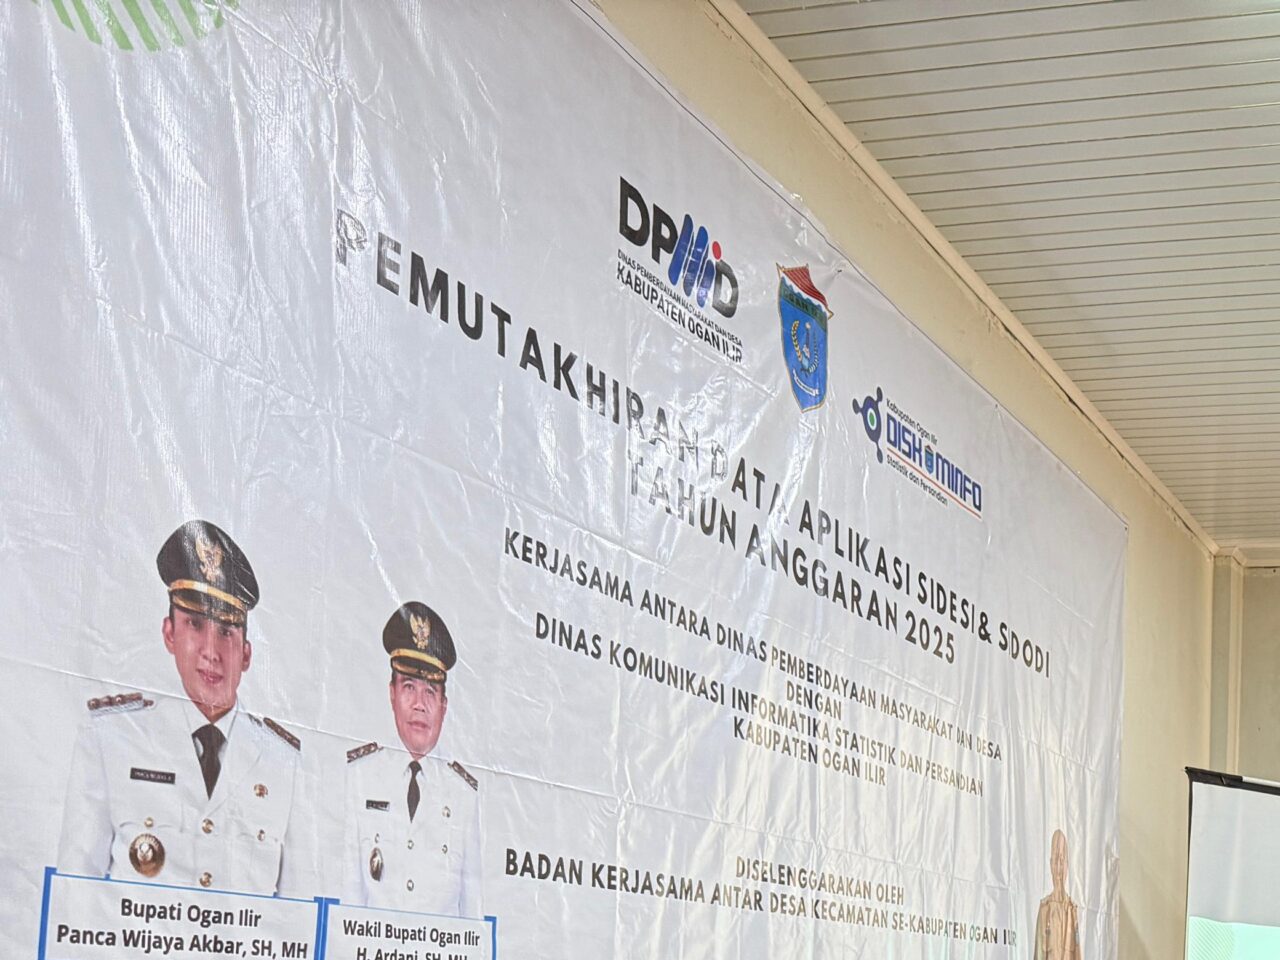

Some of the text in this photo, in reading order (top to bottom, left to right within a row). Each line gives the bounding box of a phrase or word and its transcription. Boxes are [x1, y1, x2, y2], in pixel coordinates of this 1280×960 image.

[619, 176, 739, 318] DPMD
[617, 261, 742, 363] KABUPATEN OGAN ILIR
[335, 208, 699, 470] PEMUTAKHIRAN
[710, 439, 790, 526] DATA
[799, 500, 911, 595] APLIKASI
[917, 572, 975, 634] SIDESI
[978, 611, 993, 645] &
[886, 412, 982, 512] DISKMINFO
[627, 449, 955, 665] TAHUN ANGGARAN 2025
[504, 527, 1002, 761] KERJASAMA ANTARA DINAS PEMBERDAYAAN MASYARAKAT DAN DESA
[535, 612, 983, 797] DINAS KOMUNIKASI INFORMATIKA STATISTIK DAN PERSANDIAN
[786, 680, 842, 721] DENGAN
[733, 716, 886, 786] KABUPATEN OGAN ILIR
[120, 898, 262, 928] Bupati Ogan Ilir
[505, 848, 583, 885] BADAN
[591, 862, 705, 903] KERJASAMA
[710, 883, 763, 911] ANTAR
[770, 891, 807, 918] DESA
[811, 899, 888, 928] KECAMATAN
[892, 912, 967, 940] SE-KABUPATEN
[969, 924, 998, 944] OGAN
[736, 856, 904, 905] DISELENGGARAKAN OLEH
[56, 924, 309, 960] Panca Wijaya Akbar, SH, MH
[343, 918, 481, 948] Wakil Bupati Ogan Ilir
